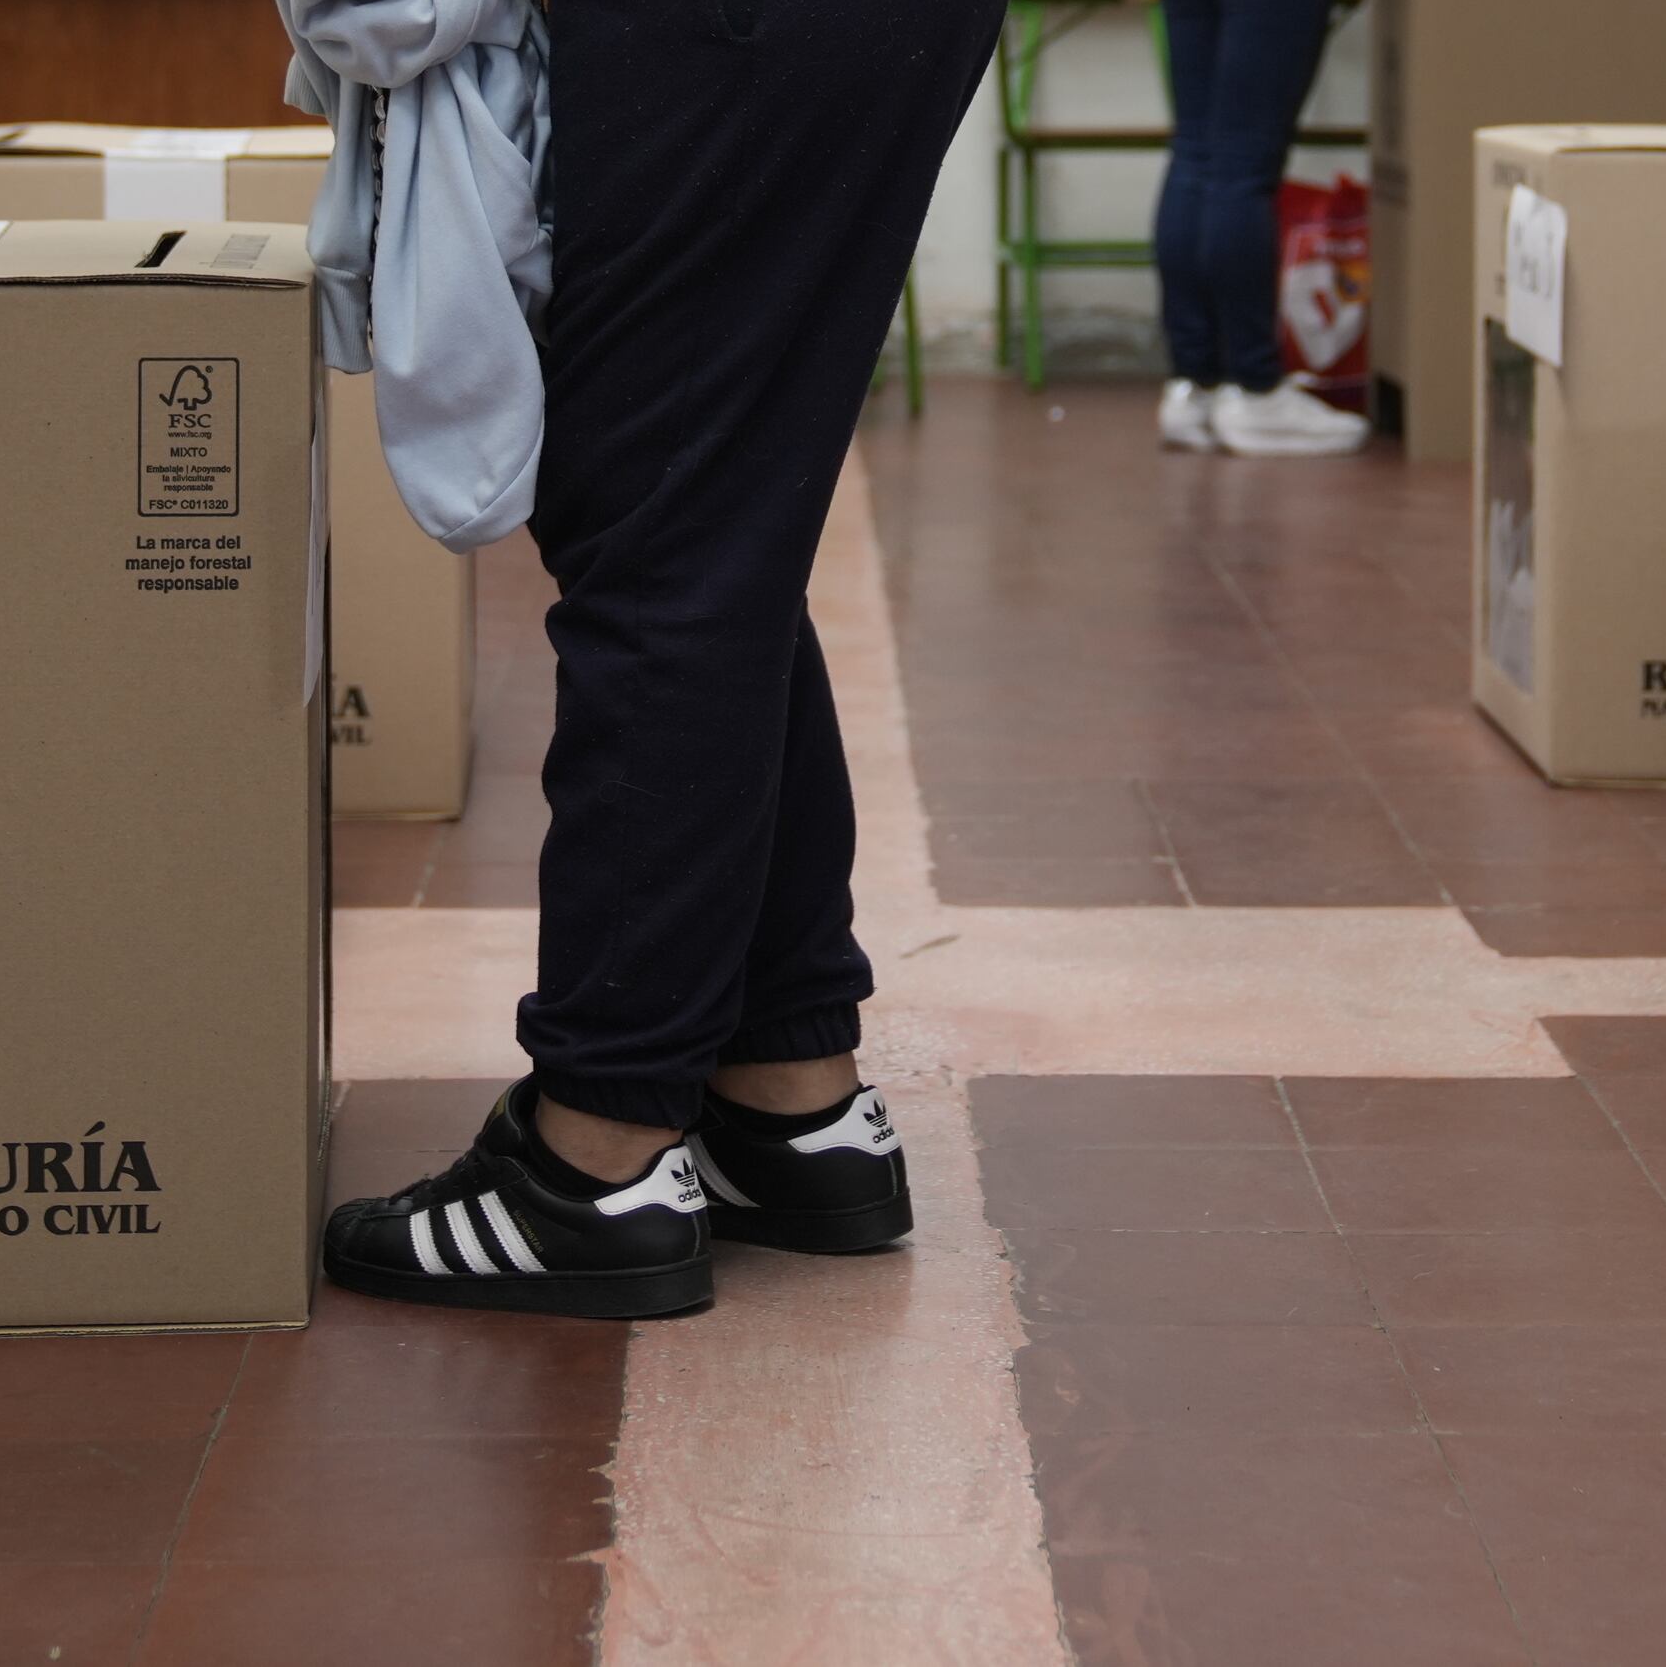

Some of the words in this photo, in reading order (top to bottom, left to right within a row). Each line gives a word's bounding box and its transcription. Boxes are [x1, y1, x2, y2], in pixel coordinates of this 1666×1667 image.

[168, 414, 212, 428] FSC
[168, 431, 212, 439] www.fsc.org
[170, 448, 207, 457] MIXTO
[146, 465, 184, 475] Embalaje
[191, 465, 231, 475] Apoyando
[164, 484, 213, 492] responsable
[181, 500, 228, 510] C011320
[136, 536, 155, 550] La
[161, 539, 210, 550] marca
[215, 535, 241, 550] del
[125, 556, 184, 573] manejo
[190, 556, 251, 570] forestal
[138, 576, 239, 594] responsable
[42, 1199, 161, 1236] CIVIL
[512, 1208, 544, 1253] SUPERSTAR
